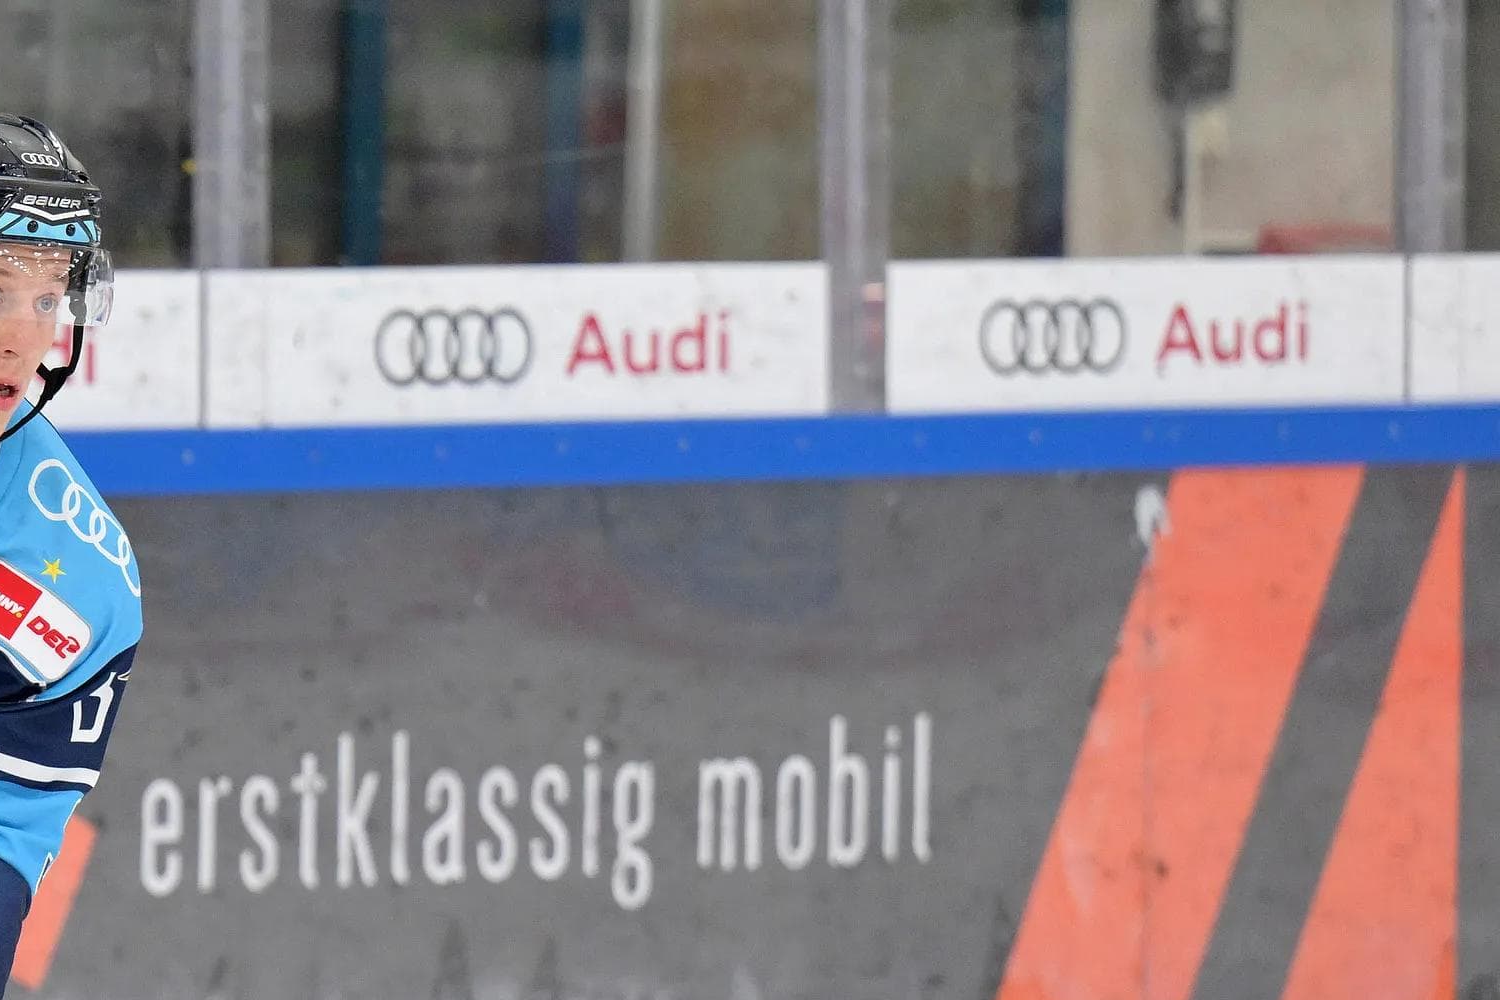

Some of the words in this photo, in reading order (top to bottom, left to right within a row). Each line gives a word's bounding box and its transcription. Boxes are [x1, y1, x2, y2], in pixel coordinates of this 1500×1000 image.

[22, 195, 81, 209] BAUER
[566, 310, 731, 376] Audi
[1156, 301, 1311, 364] Audi
[139, 730, 655, 910] erstklassig
[697, 713, 932, 872] mobil
